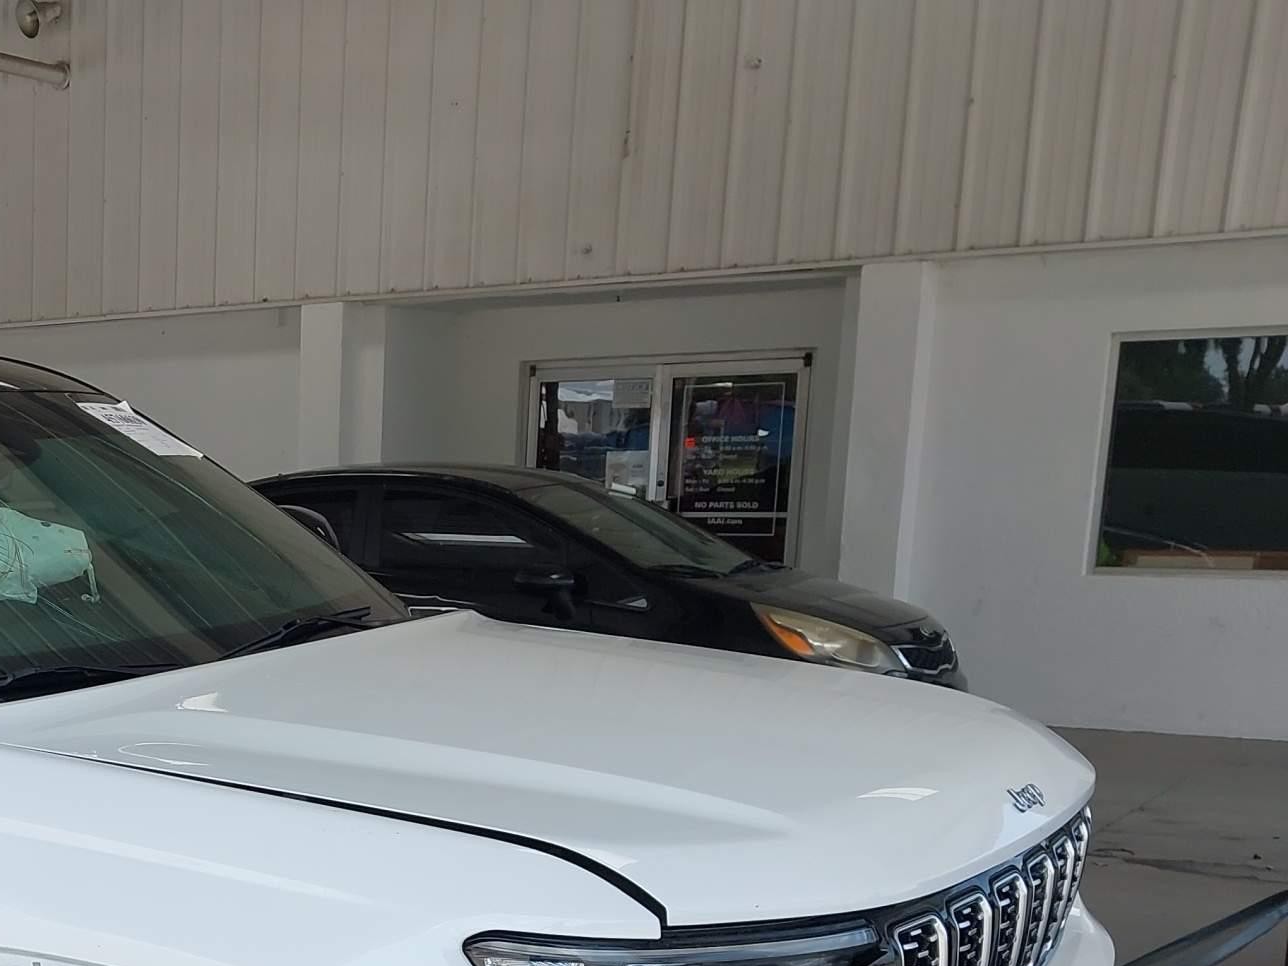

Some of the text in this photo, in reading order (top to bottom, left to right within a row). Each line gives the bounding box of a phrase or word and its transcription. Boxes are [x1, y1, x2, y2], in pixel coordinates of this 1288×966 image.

[694, 501, 759, 509] NO PARTS SOLD
[1007, 784, 1045, 813] Jeep
